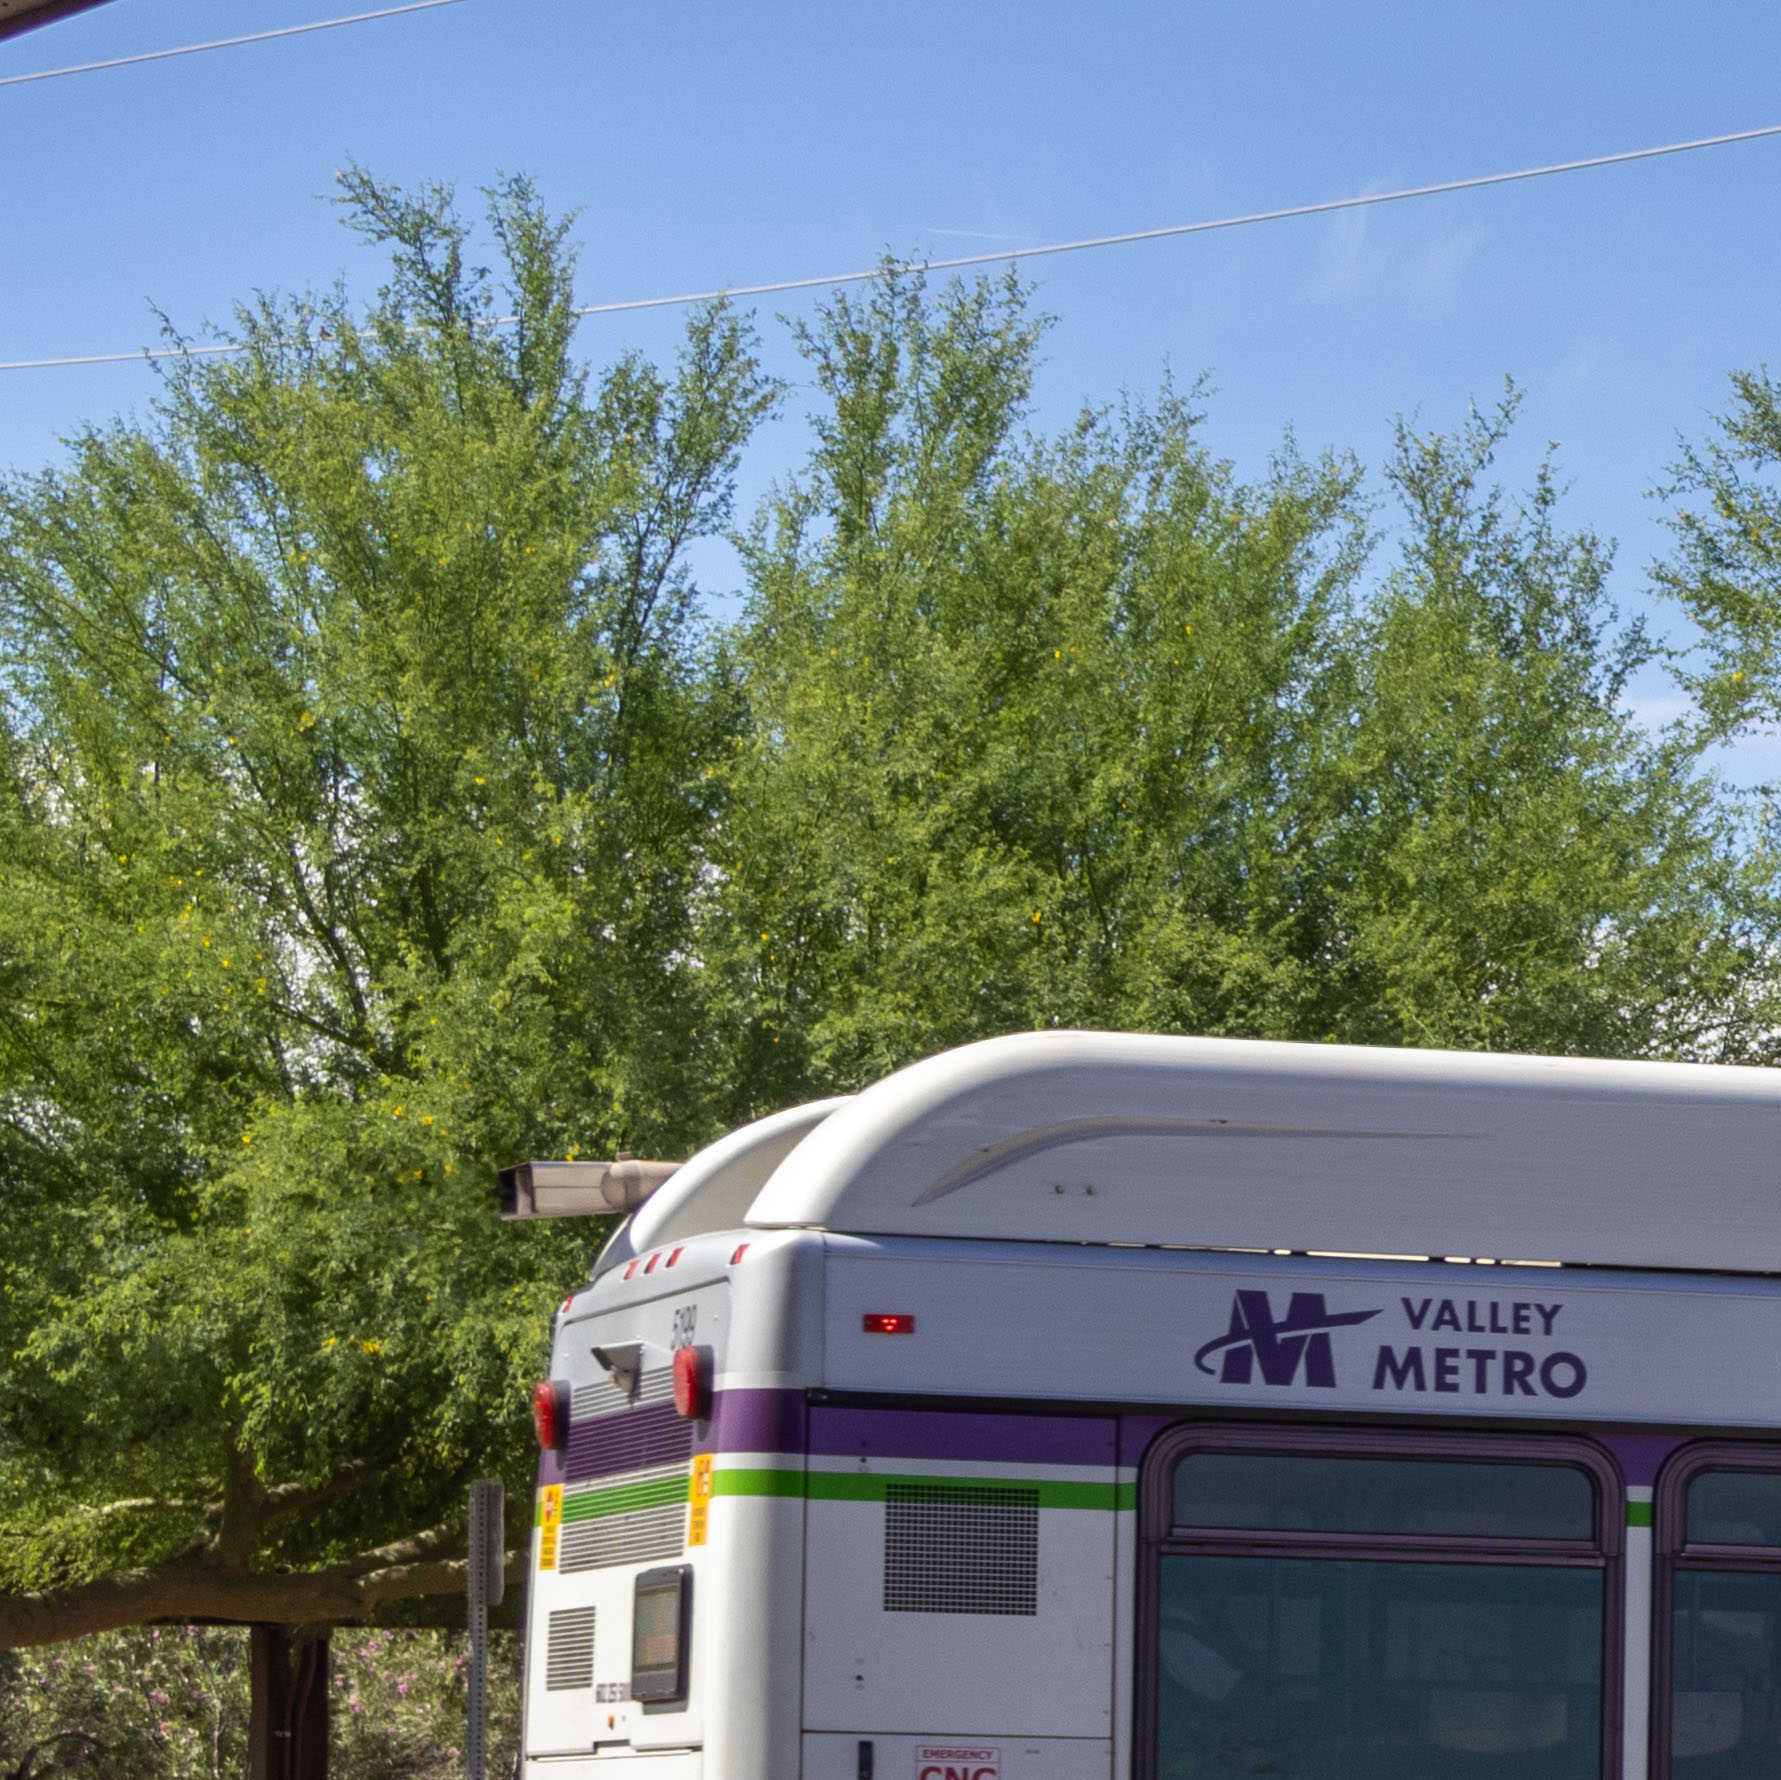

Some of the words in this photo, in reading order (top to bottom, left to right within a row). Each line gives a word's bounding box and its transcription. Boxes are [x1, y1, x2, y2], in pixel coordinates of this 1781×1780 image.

[1401, 1297, 1563, 1336] VALLEY
[1373, 1345, 1588, 1399] METRO
[922, 1749, 993, 1761] EMERGENCY
